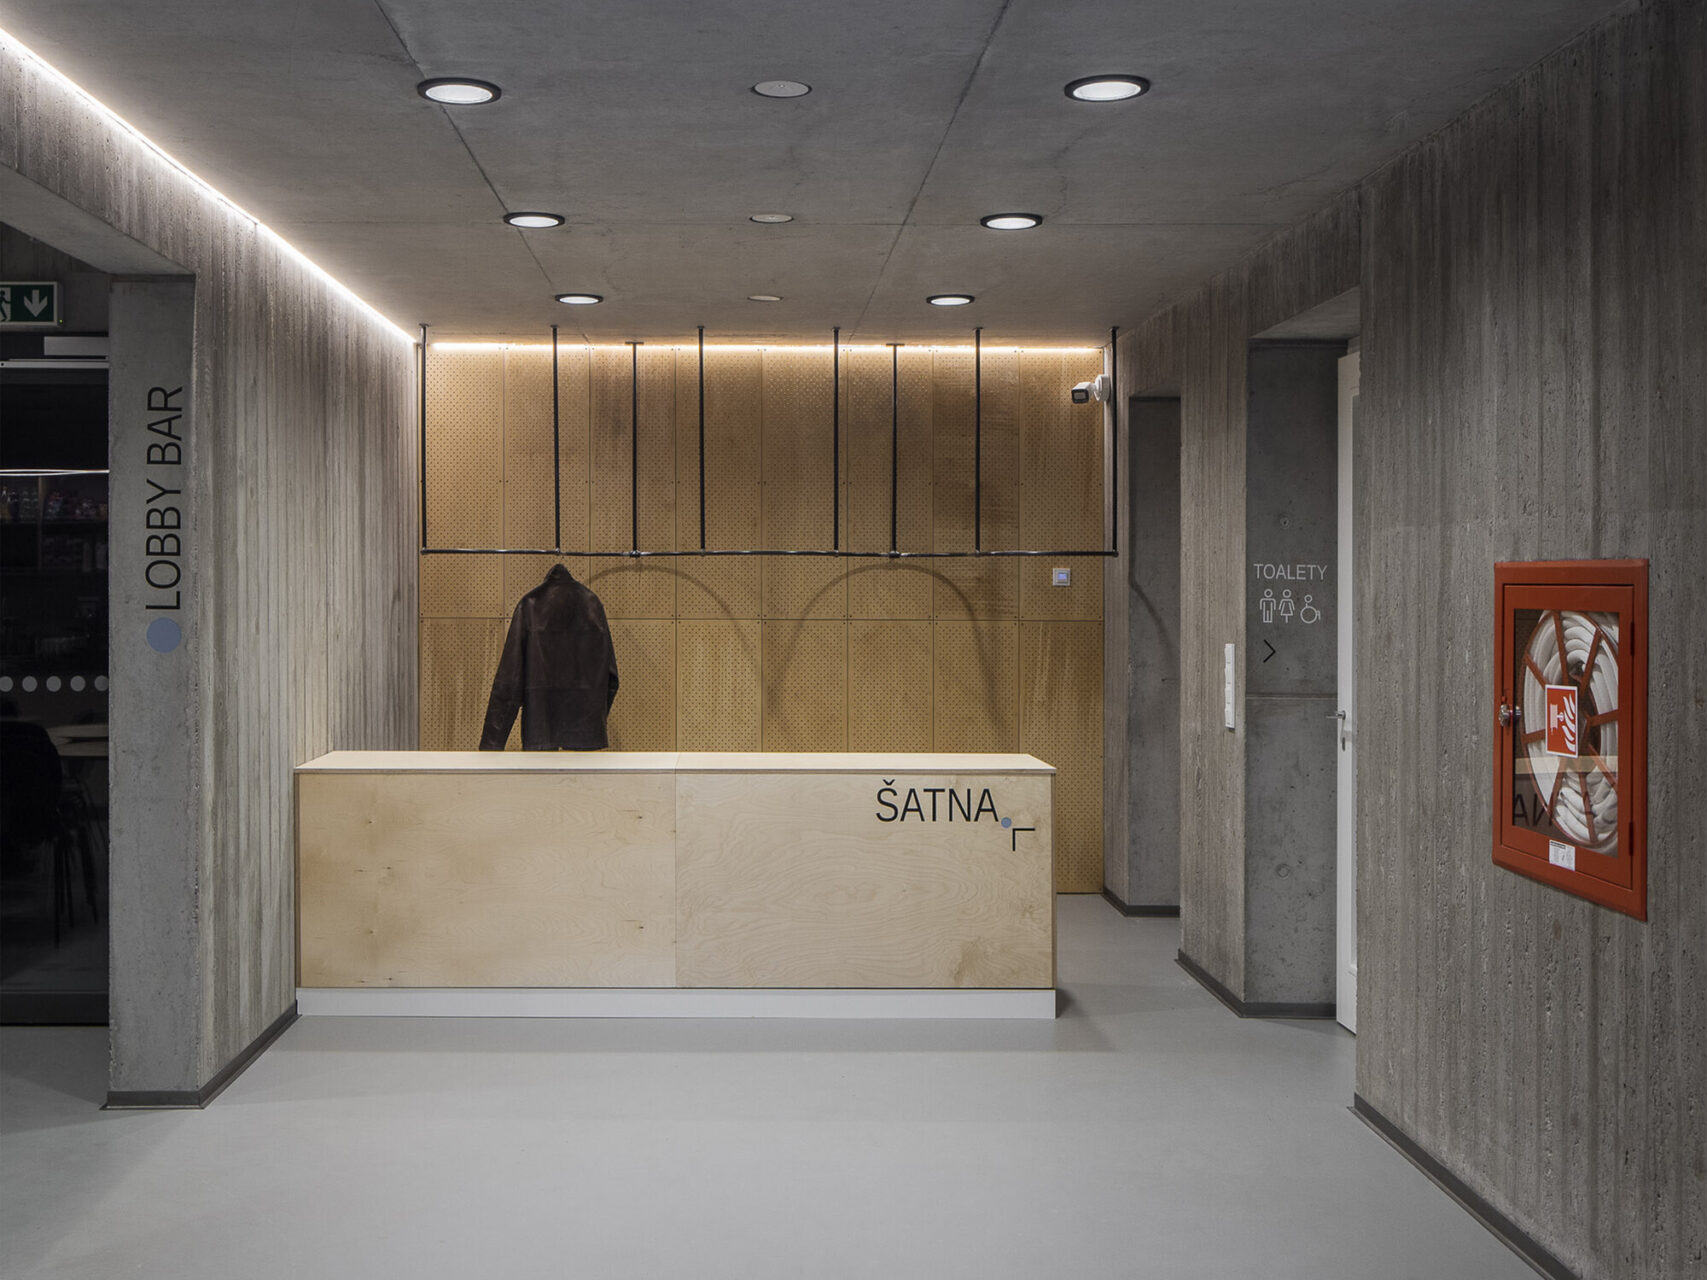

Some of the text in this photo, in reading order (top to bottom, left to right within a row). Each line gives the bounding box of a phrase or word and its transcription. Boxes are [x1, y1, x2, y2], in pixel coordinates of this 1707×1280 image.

[145, 386, 183, 610] LOBBY BAR
[1253, 563, 1328, 580] TOALETY
[876, 778, 999, 823] ŠATNA
